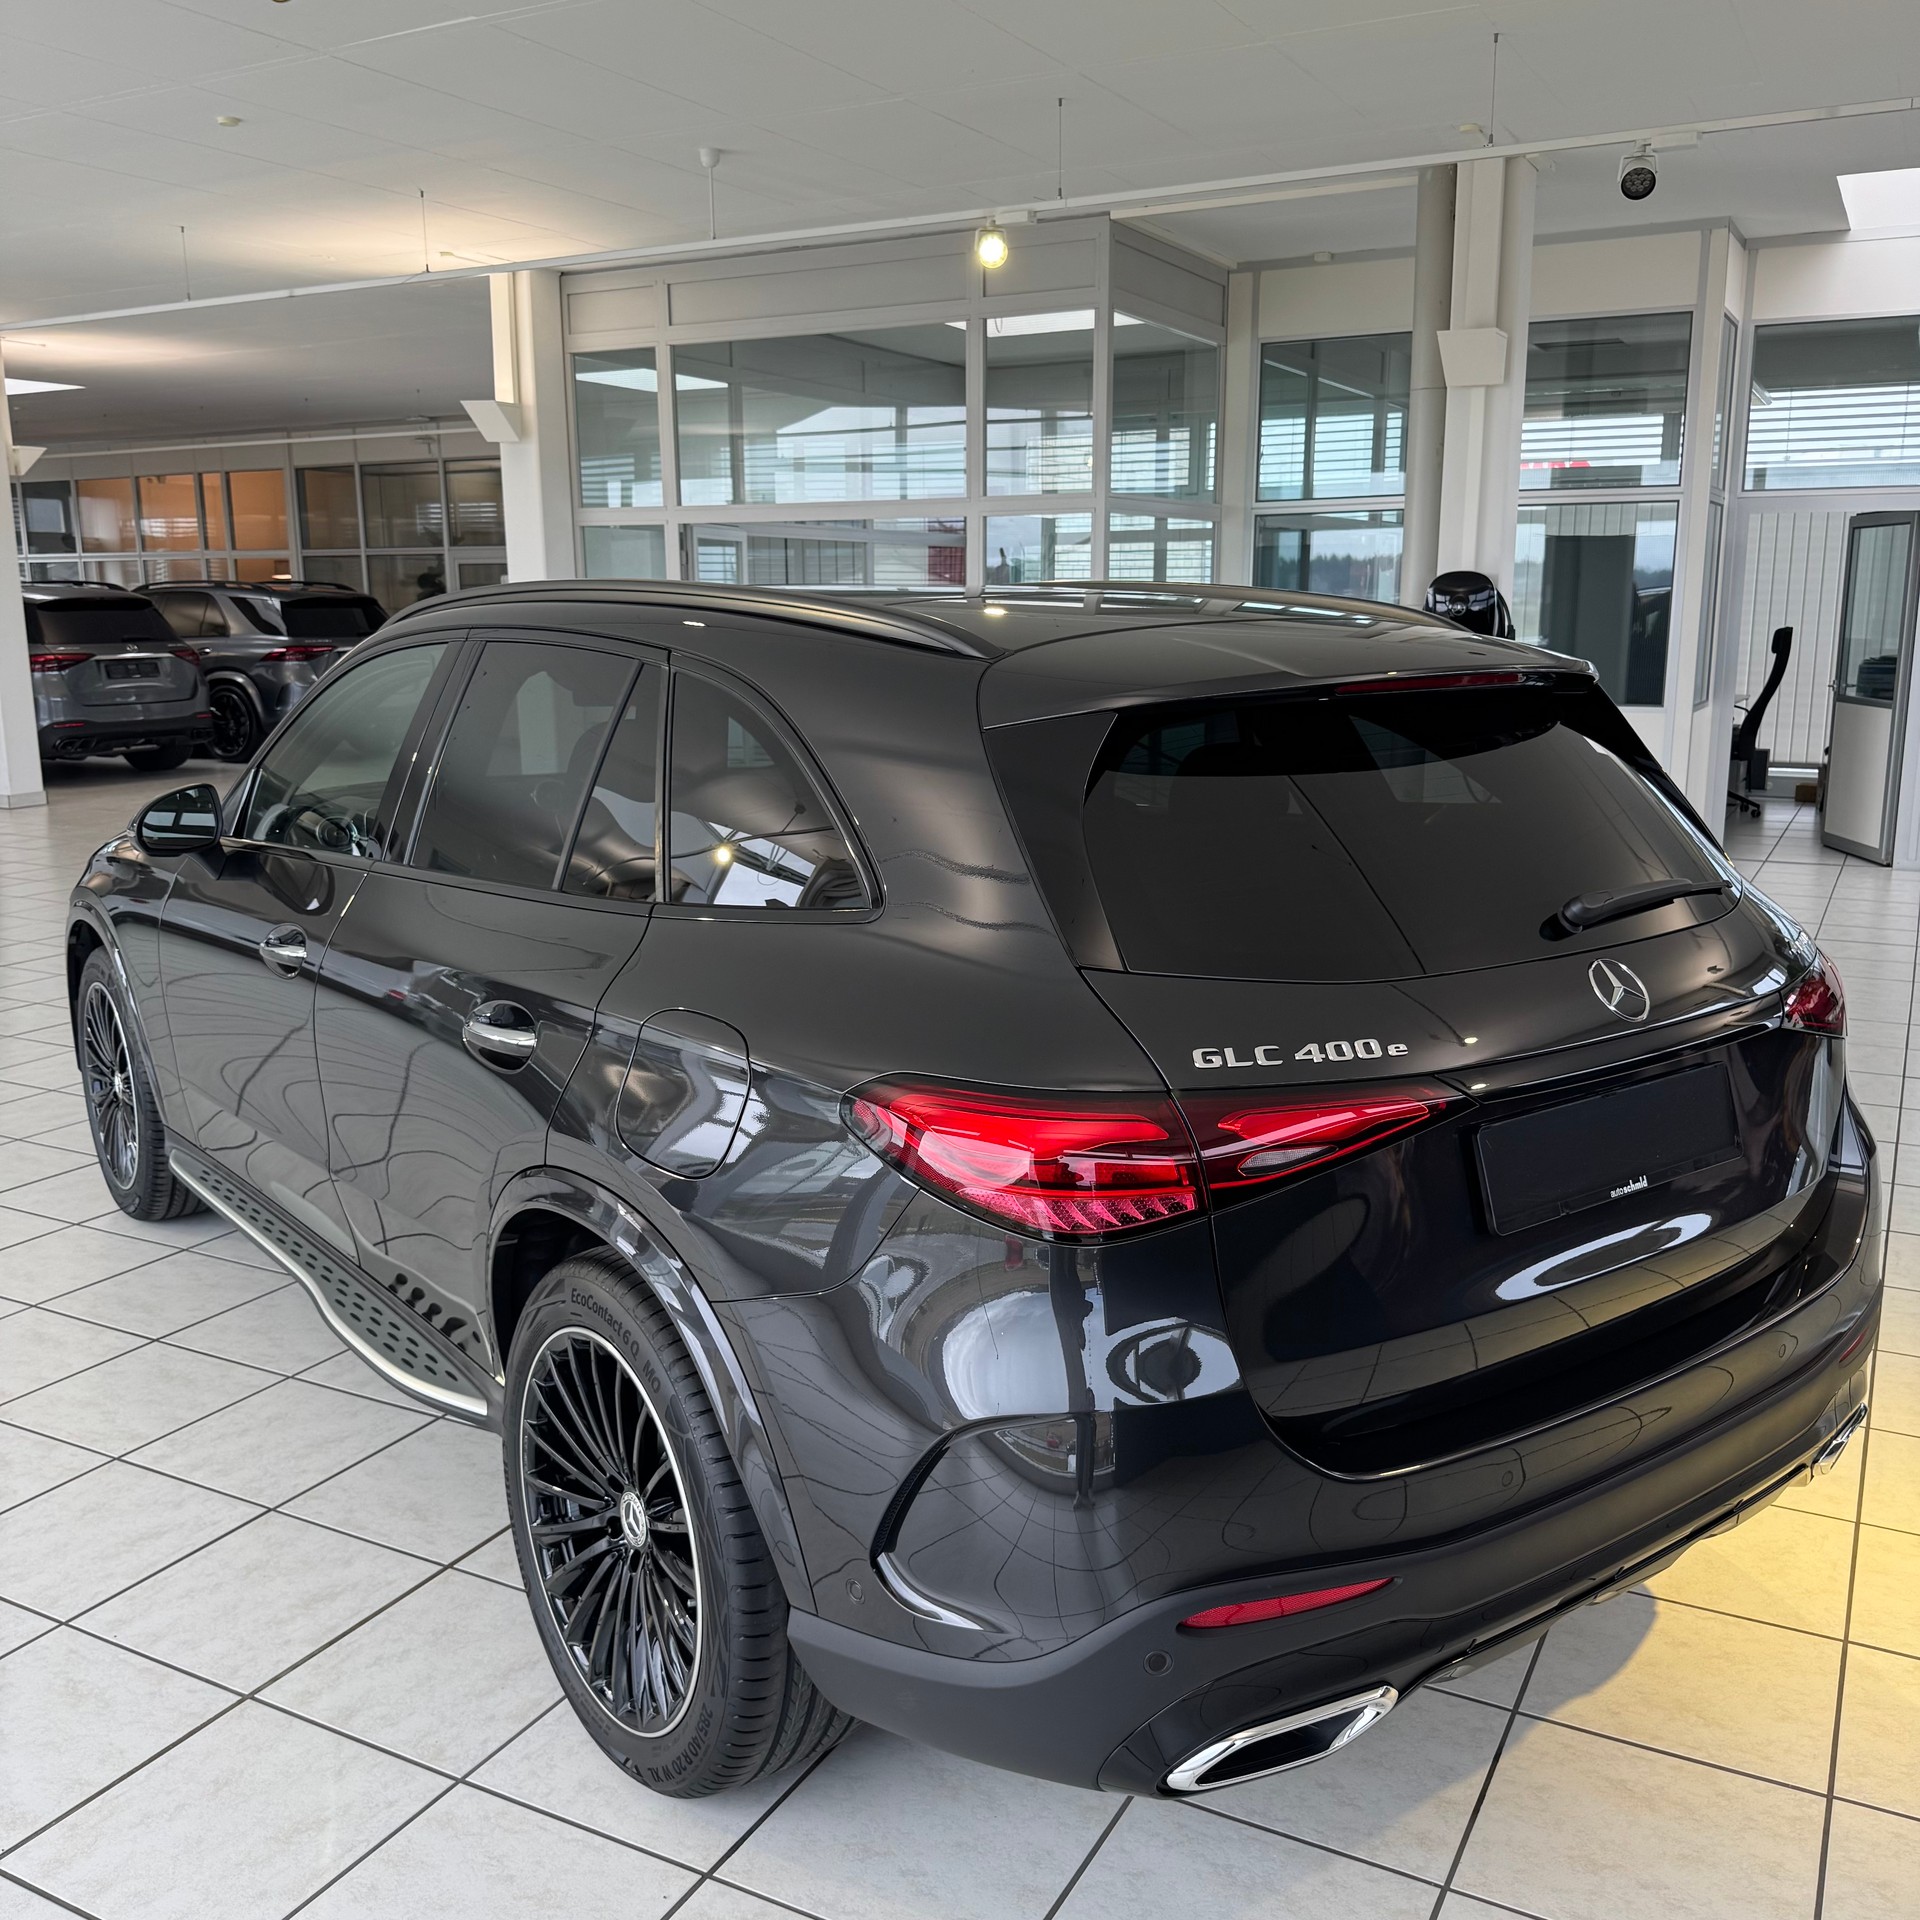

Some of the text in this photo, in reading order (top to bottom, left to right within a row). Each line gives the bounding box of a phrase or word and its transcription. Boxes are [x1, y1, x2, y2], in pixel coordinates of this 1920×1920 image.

[1192, 1045, 1284, 1069] GLC
[570, 1287, 661, 1394] EcoContact 6 Q MO
[687, 1702, 713, 1757] 285/40
[647, 1767, 664, 1783] XL
